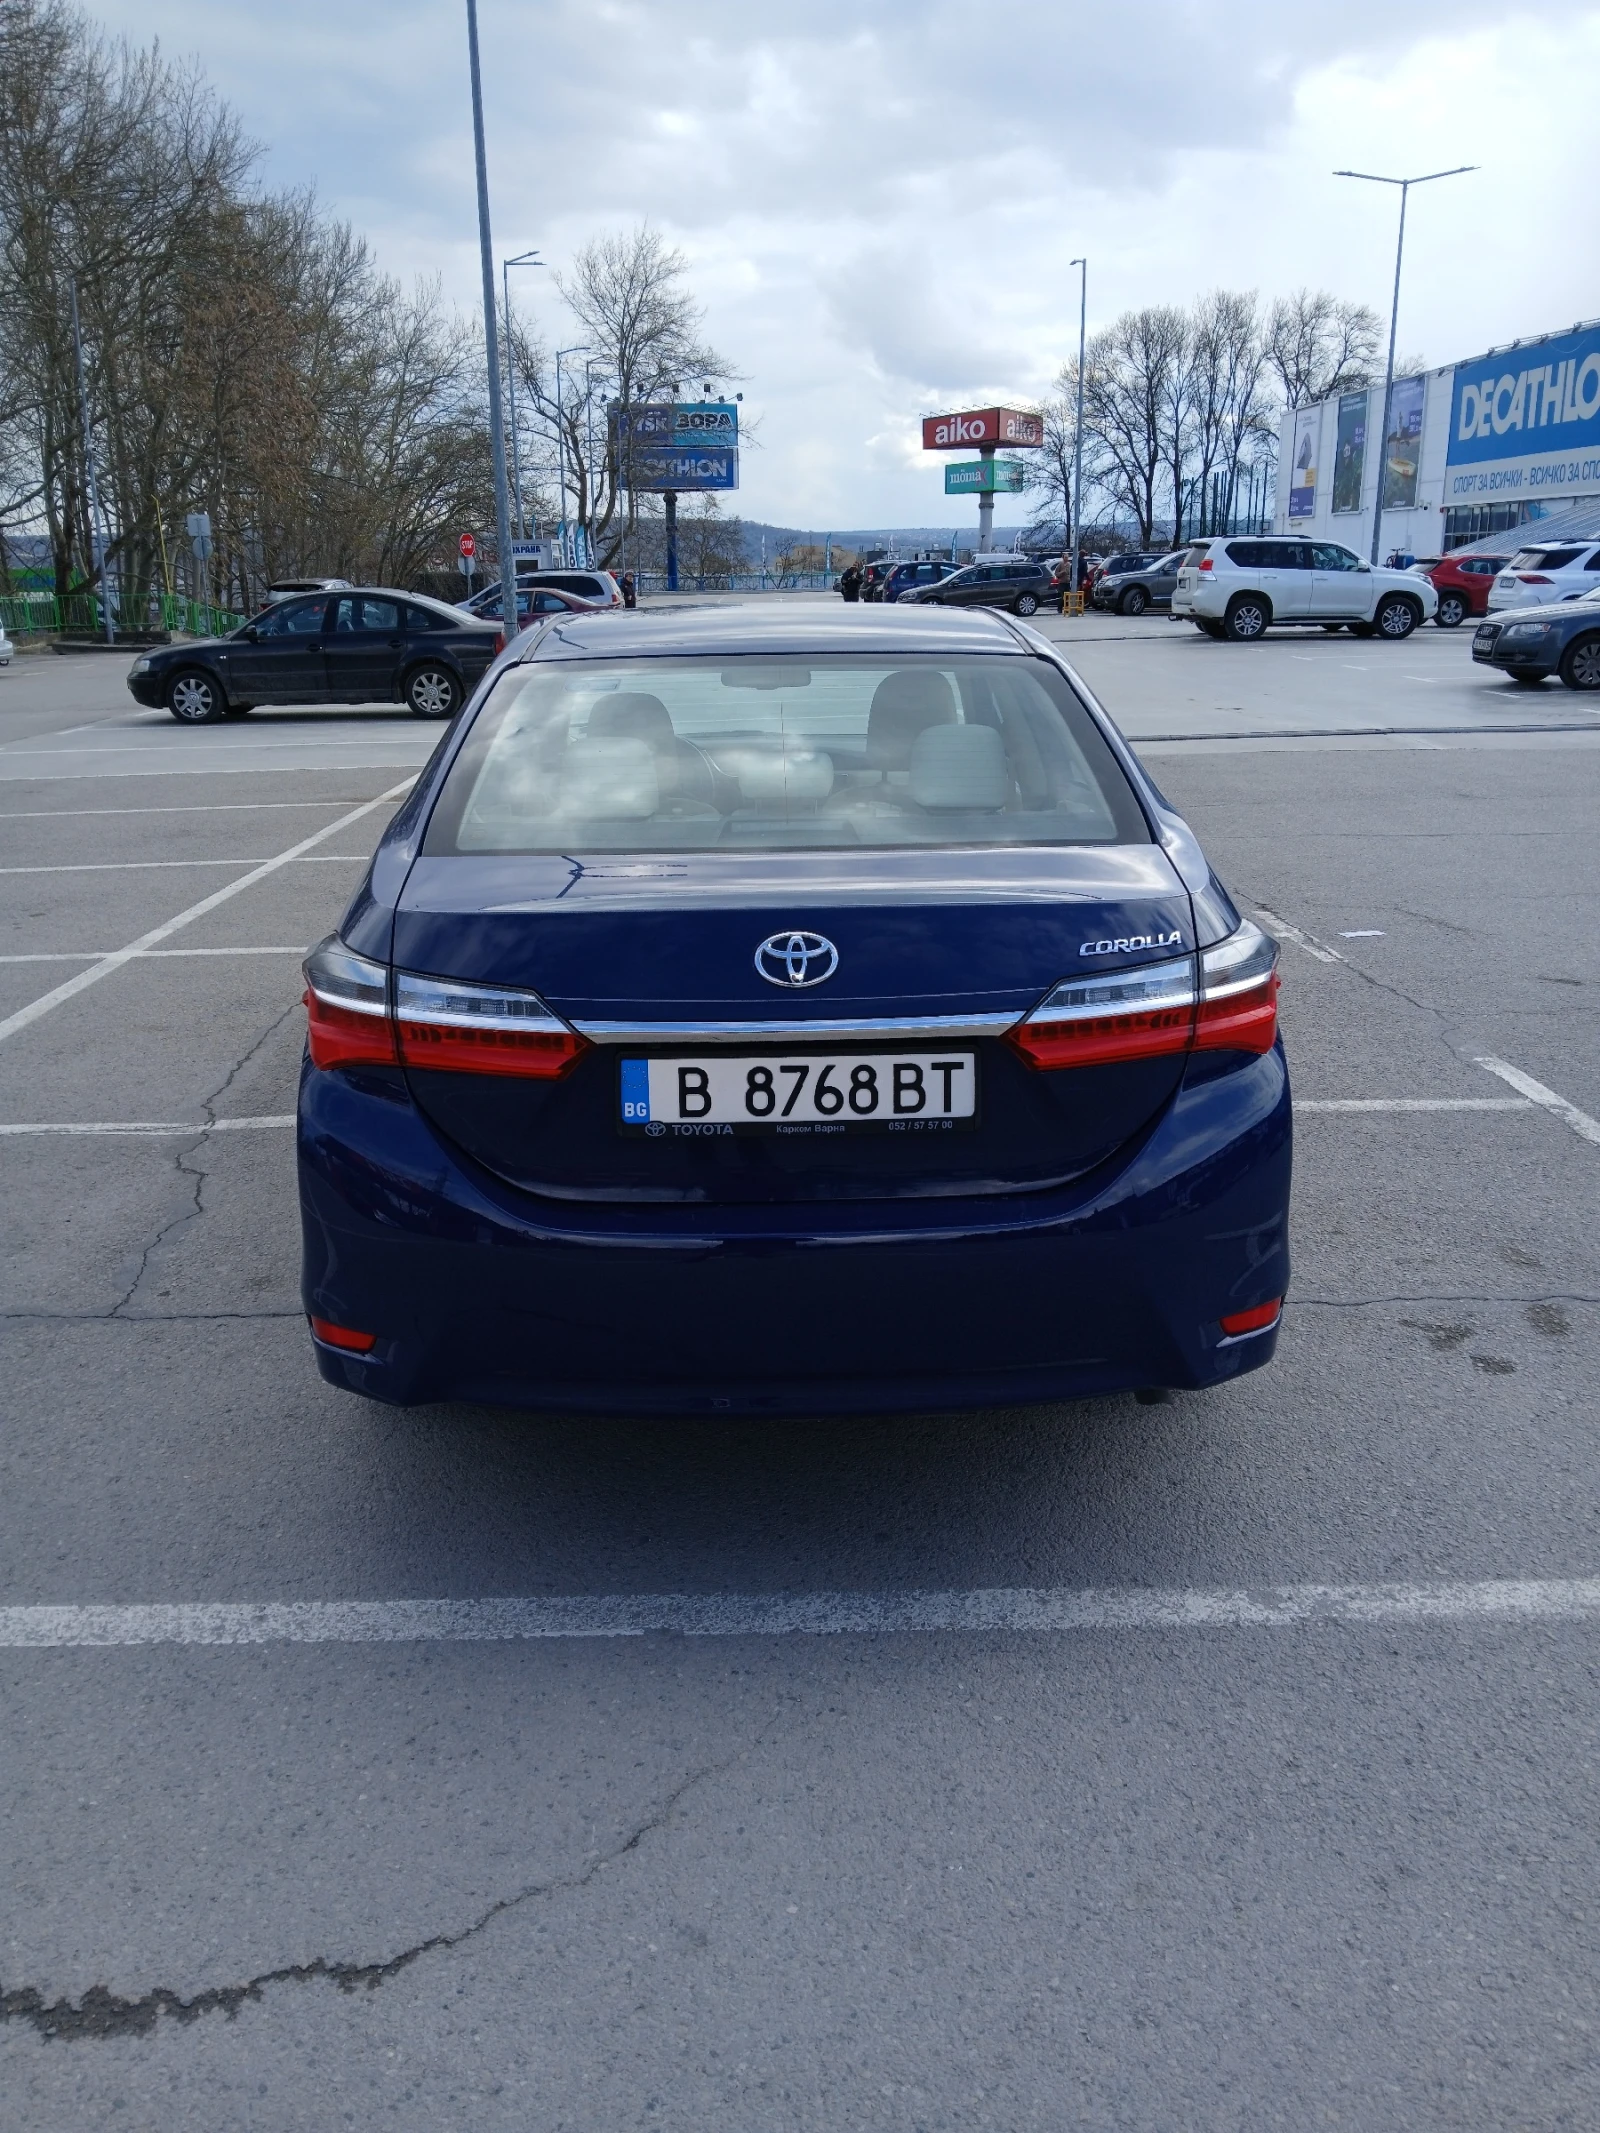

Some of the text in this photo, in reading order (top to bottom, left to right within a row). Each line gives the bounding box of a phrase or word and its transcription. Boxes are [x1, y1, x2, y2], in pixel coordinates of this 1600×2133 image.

[675, 412, 733, 430] ЗОРА
[935, 417, 986, 444] aiko
[1453, 473, 1478, 494] СПОРТ
[1477, 471, 1488, 491] ЗА
[1489, 468, 1523, 489] ВСИЧКИ
[1529, 463, 1566, 486] ВСИЧКО
[1568, 462, 1579, 482] ЗА
[461, 540, 474, 549] STOP
[1079, 930, 1182, 956] COROLLA
[624, 1102, 647, 1117] BG
[672, 1124, 734, 1136] TOYOTA
[776, 1123, 845, 1134] Карком Варна
[888, 1121, 906, 1131] 052
[913, 1121, 925, 1130] 57
[926, 1120, 939, 1130] 57
[941, 1120, 953, 1129] 00
